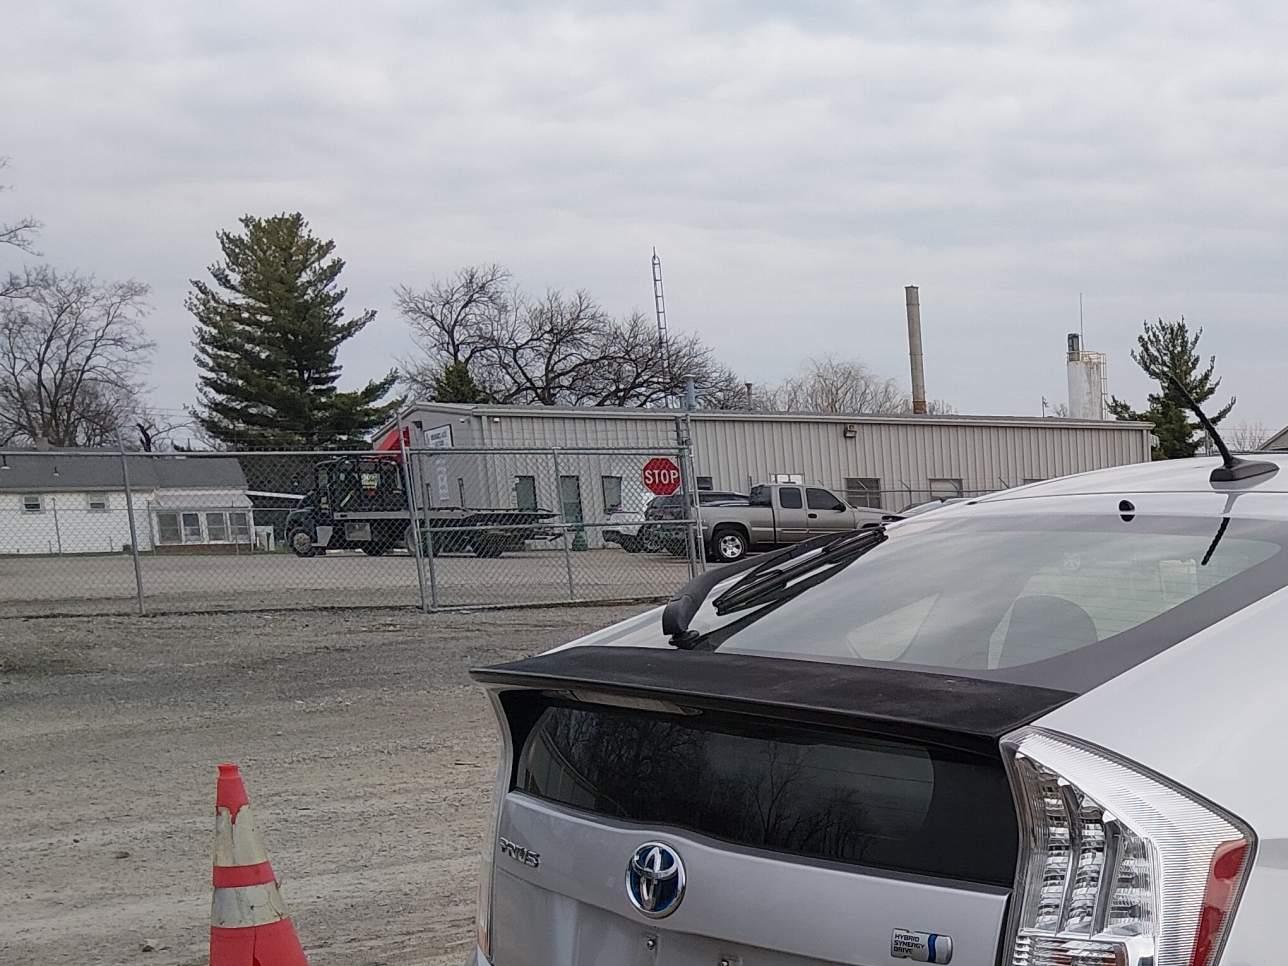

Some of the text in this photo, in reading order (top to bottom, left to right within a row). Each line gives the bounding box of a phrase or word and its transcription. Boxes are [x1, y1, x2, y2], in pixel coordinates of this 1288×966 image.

[644, 469, 679, 485] STOP
[894, 934, 920, 942] HYBRID
[894, 940, 925, 949] SYNERGY
[893, 946, 913, 955] DRIVE
